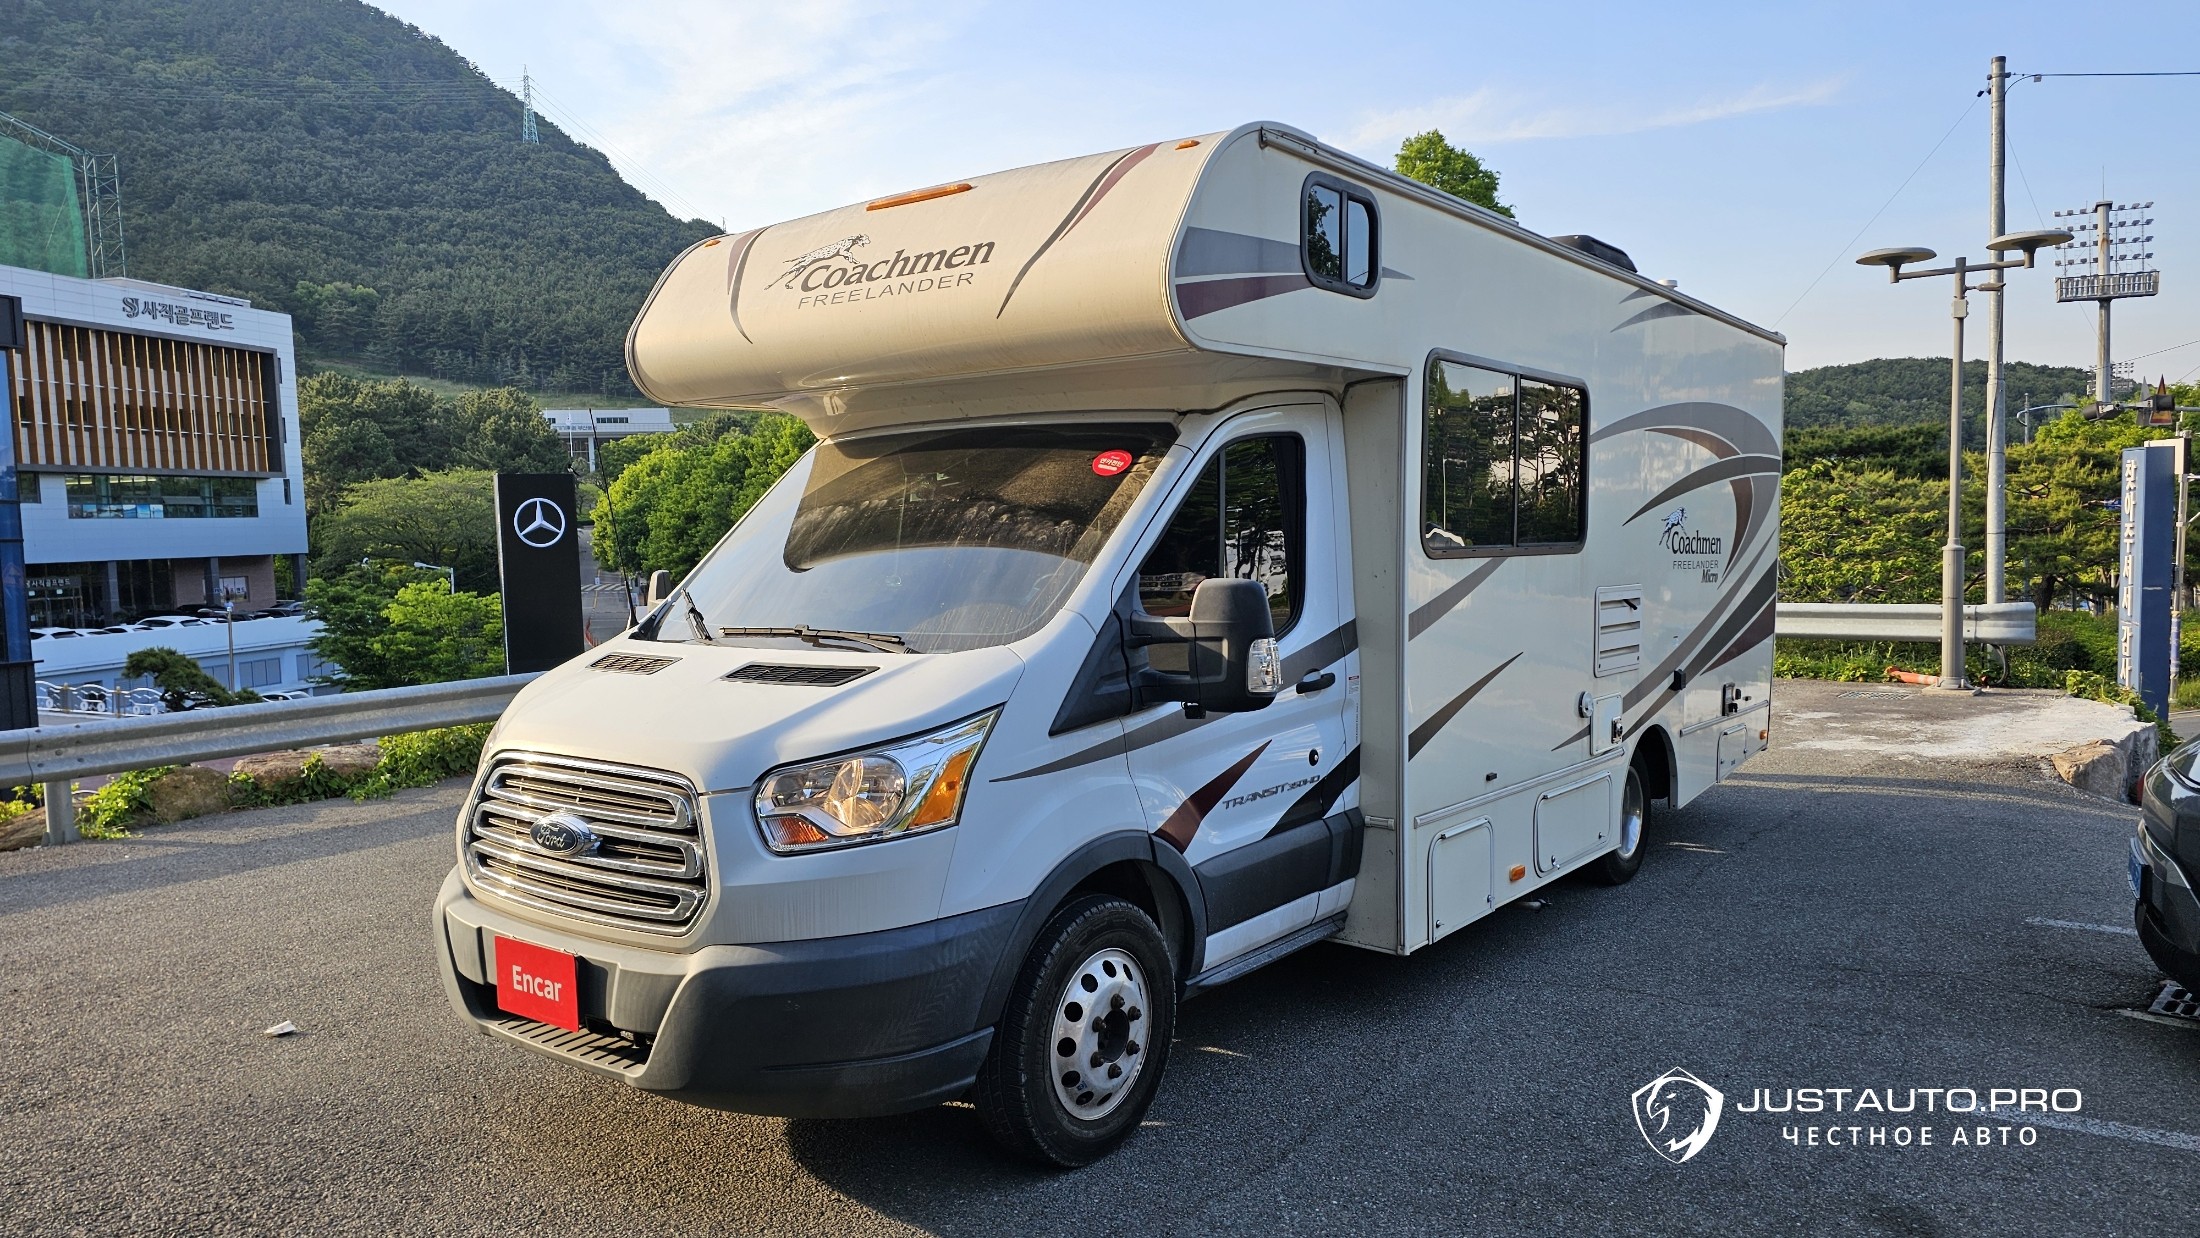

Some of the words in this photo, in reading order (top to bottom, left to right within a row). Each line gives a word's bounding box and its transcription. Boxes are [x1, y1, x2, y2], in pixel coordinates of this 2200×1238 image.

[800, 241, 996, 293] Coachmen
[797, 272, 974, 310] FREELANDER
[141, 301, 235, 330] 사직골프랜드
[1671, 529, 1722, 555] Coachmen
[1672, 560, 1719, 570] FREELANDER
[1701, 568, 1719, 583] Micro
[1222, 782, 1288, 810] TRANSIT
[536, 823, 567, 849] Ford
[512, 964, 562, 1002] Encar
